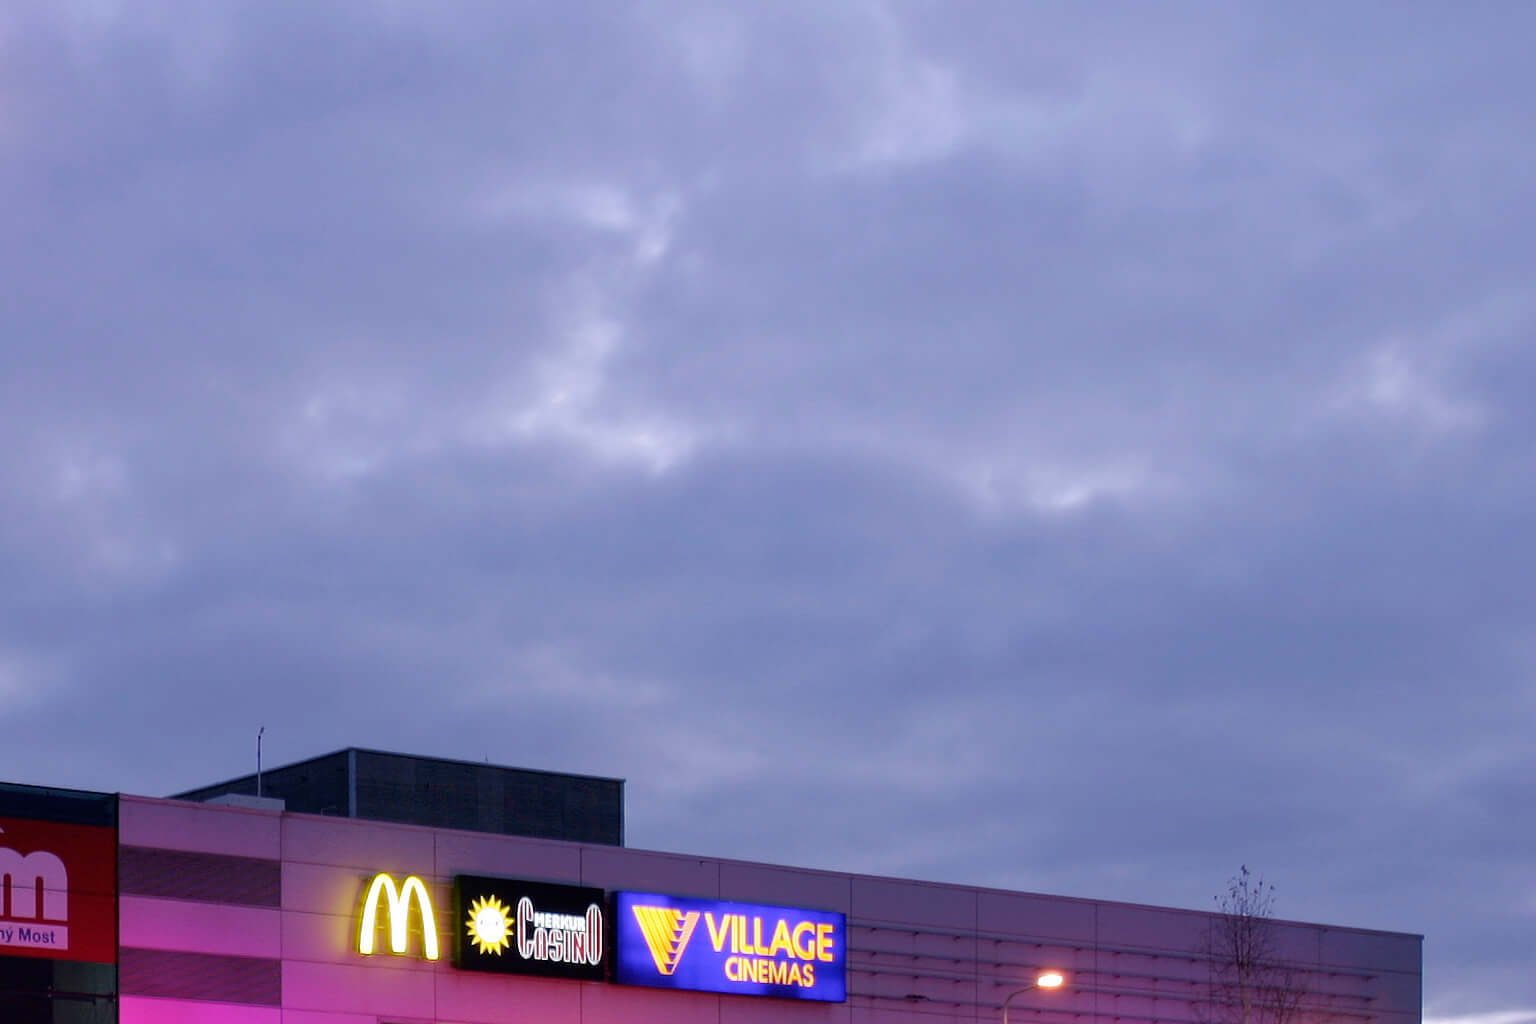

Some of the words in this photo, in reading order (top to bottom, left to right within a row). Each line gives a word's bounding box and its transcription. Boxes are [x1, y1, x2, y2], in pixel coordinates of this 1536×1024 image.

[534, 911, 586, 931] MERKUR
[18, 927, 56, 944] Most
[703, 912, 835, 962] VILLAGE
[724, 956, 815, 988] CINEMAS
